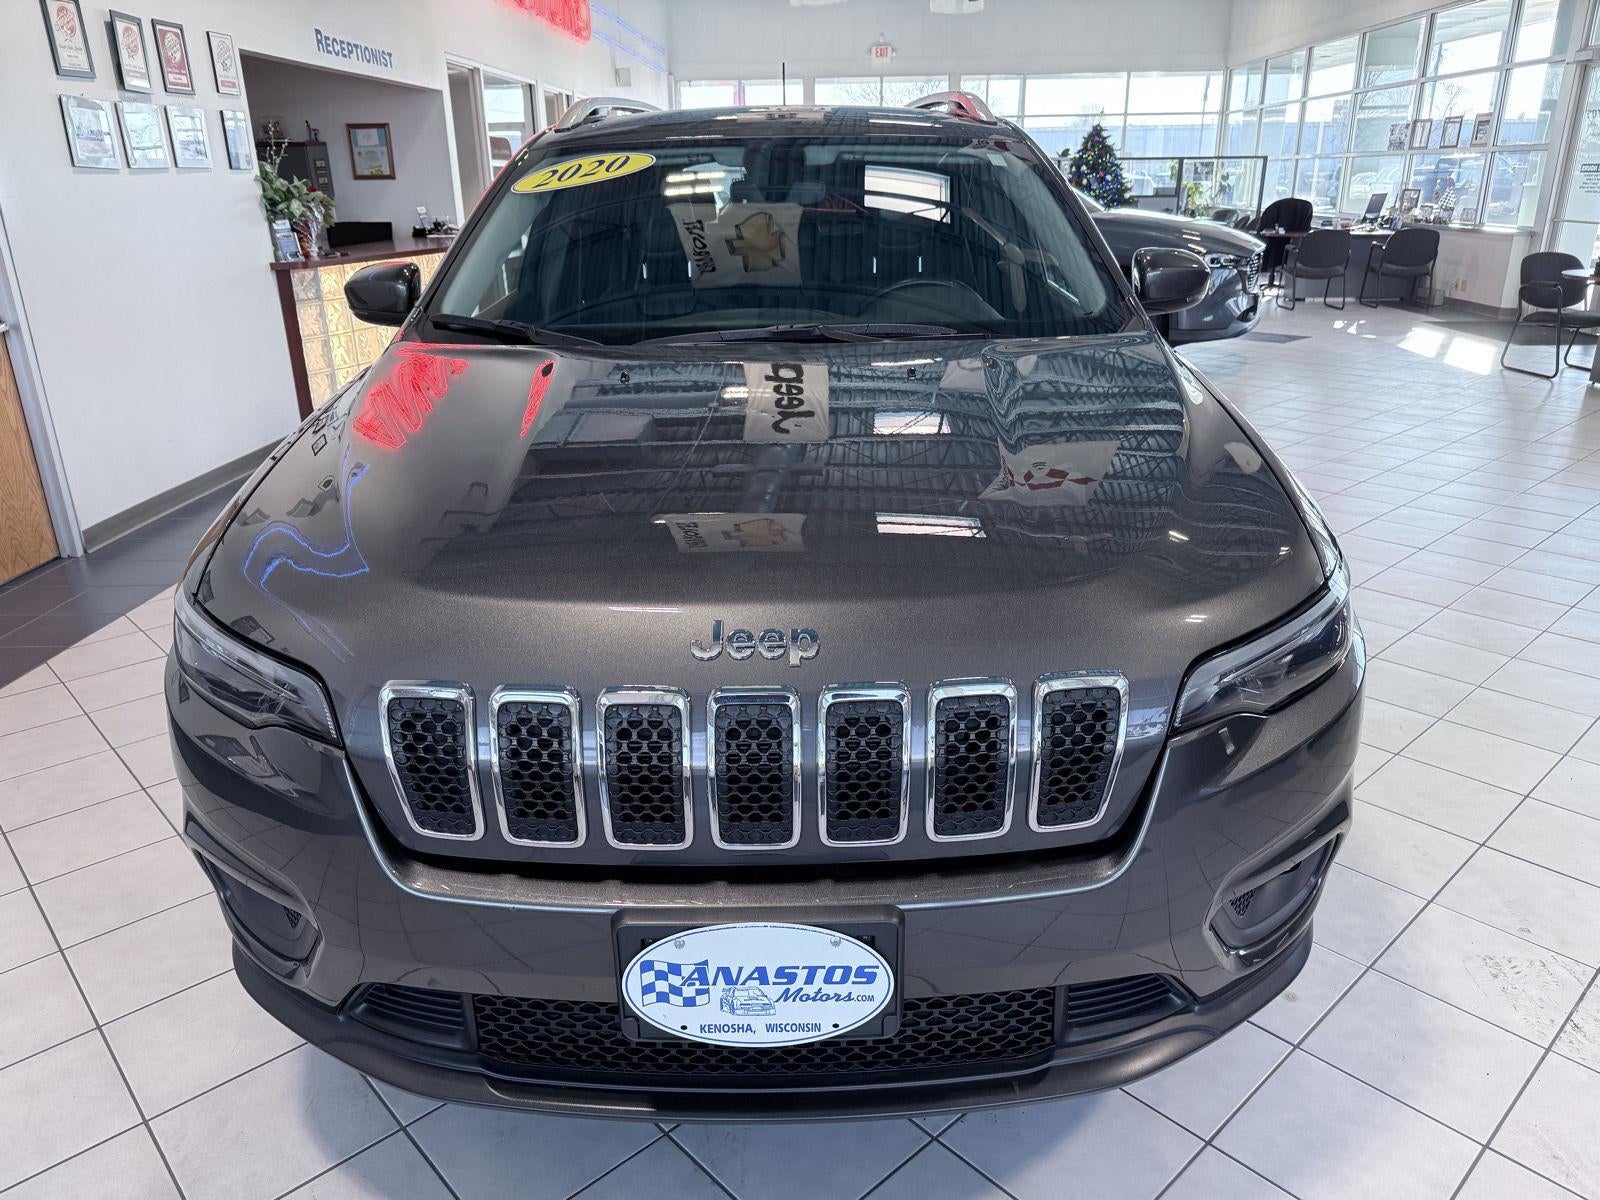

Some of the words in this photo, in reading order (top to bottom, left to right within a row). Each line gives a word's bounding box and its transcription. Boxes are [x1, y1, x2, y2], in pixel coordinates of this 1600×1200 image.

[876, 47, 888, 57] EXIT
[532, 155, 631, 189] 2020
[690, 619, 820, 667] Jeep
[679, 964, 879, 986] ANASTOS
[699, 1023, 756, 1035] KENOSHA,
[765, 1022, 822, 1033] WISCONSIN
